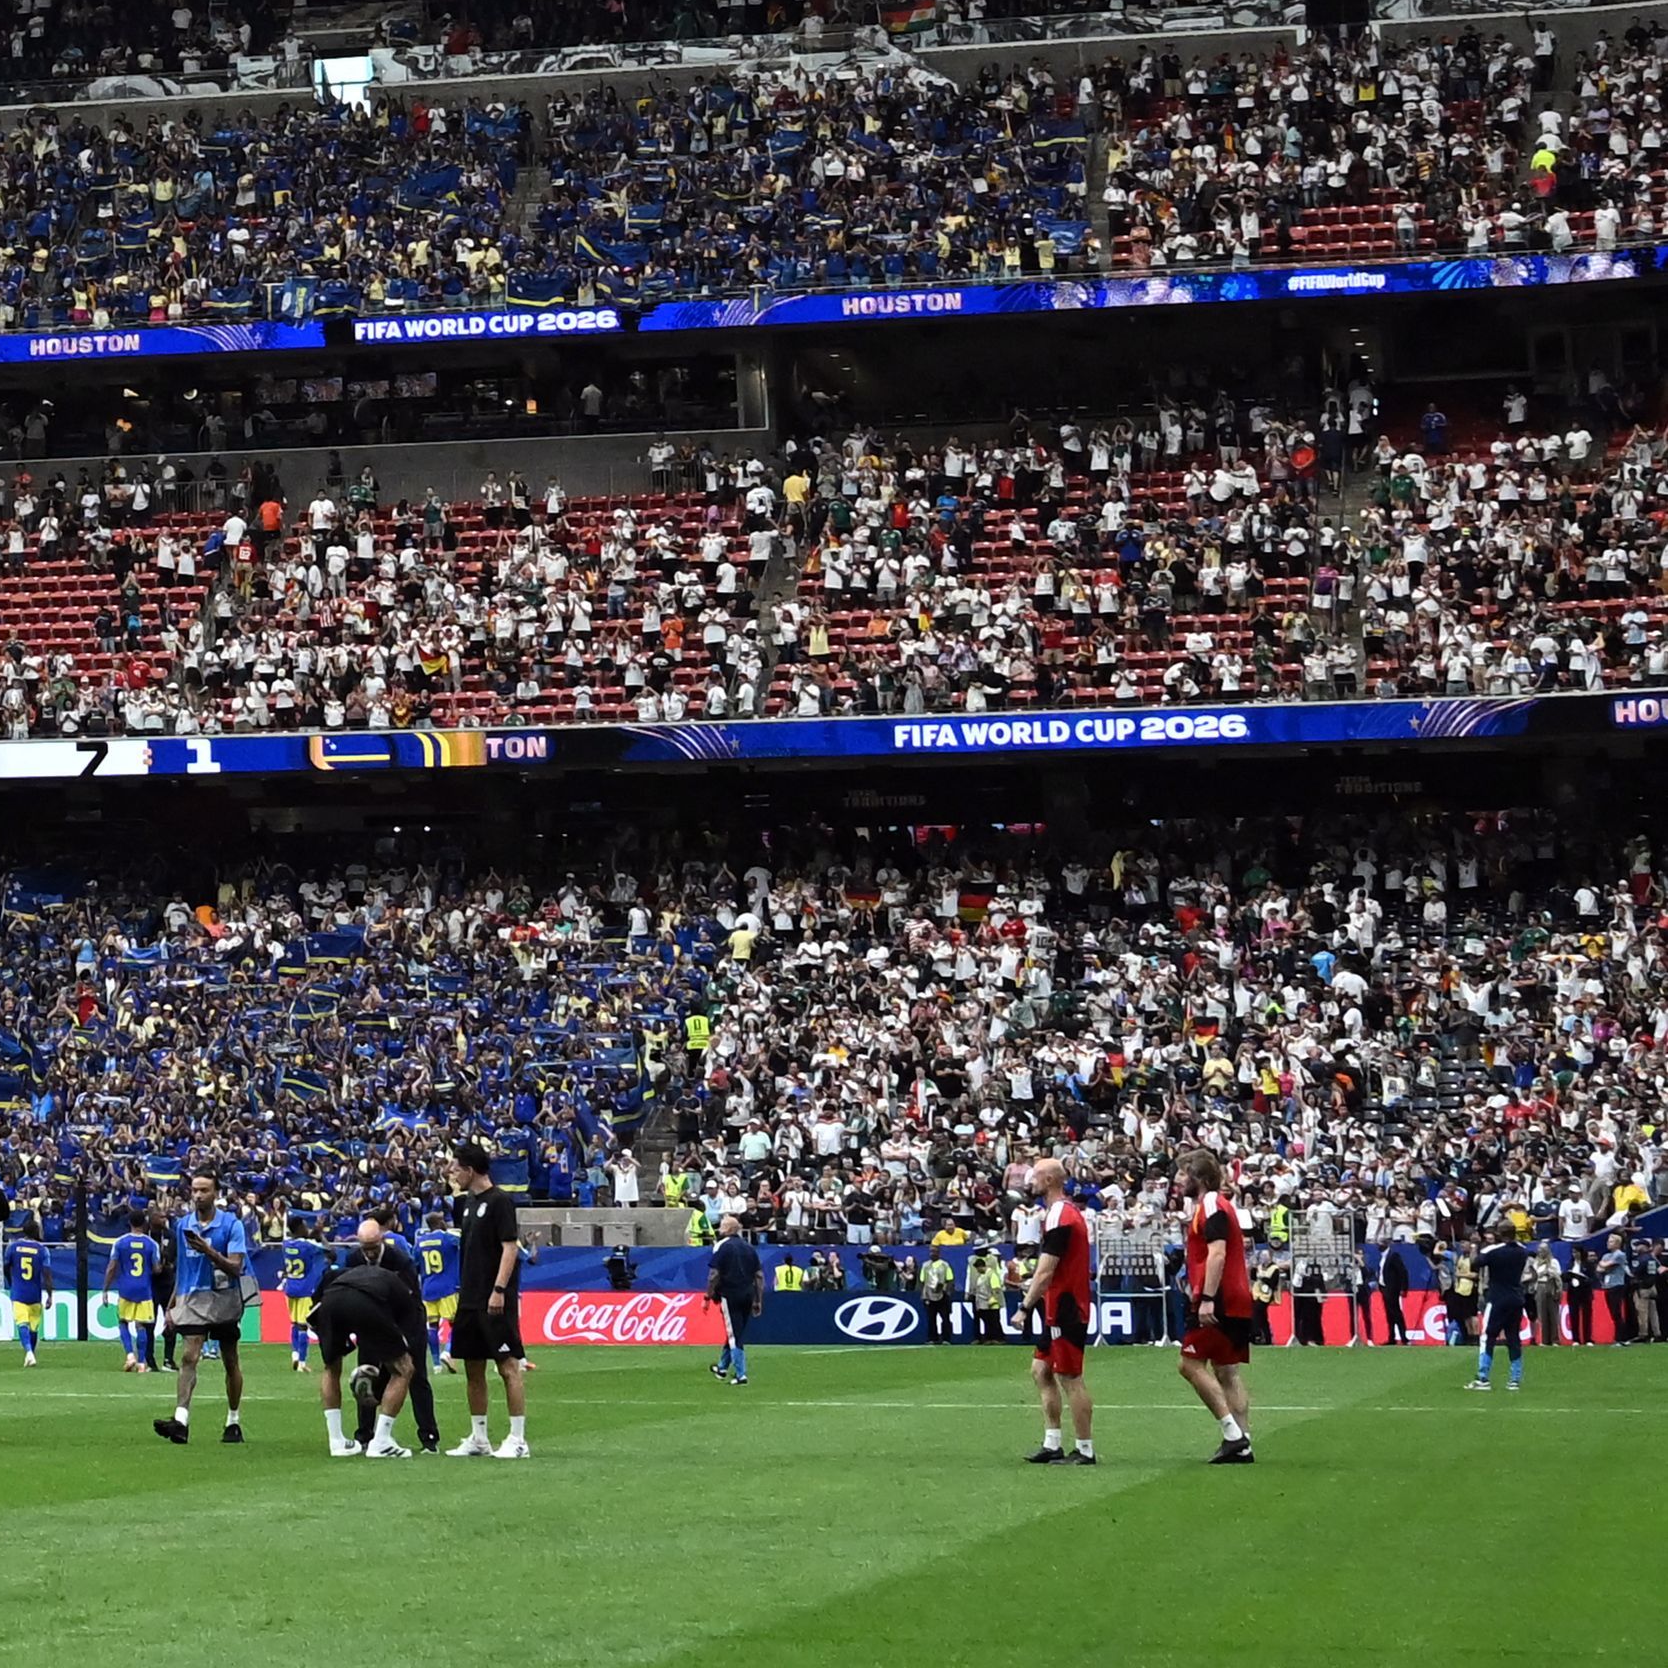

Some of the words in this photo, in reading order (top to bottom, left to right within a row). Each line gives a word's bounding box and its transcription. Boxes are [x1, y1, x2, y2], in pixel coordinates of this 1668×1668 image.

[1288, 272, 1385, 291] #FIFAWorldCup
[842, 293, 961, 315] HOUSTON
[354, 321, 402, 340] FIFA
[404, 317, 485, 338] WORLD
[488, 314, 534, 333] CUP
[537, 310, 618, 331] 2026
[30, 334, 140, 356] HOUSTON
[894, 724, 958, 748] FIFA
[961, 721, 1071, 746] WORLD
[1075, 719, 1136, 742] CUP
[1139, 714, 1250, 740] 2026
[75, 741, 109, 779] 7
[186, 738, 221, 774] 1
[20, 1257, 34, 1280] 5
[130, 1253, 144, 1277] 3
[421, 1250, 444, 1275] 19
[543, 1292, 696, 1342] Coca-Cola
